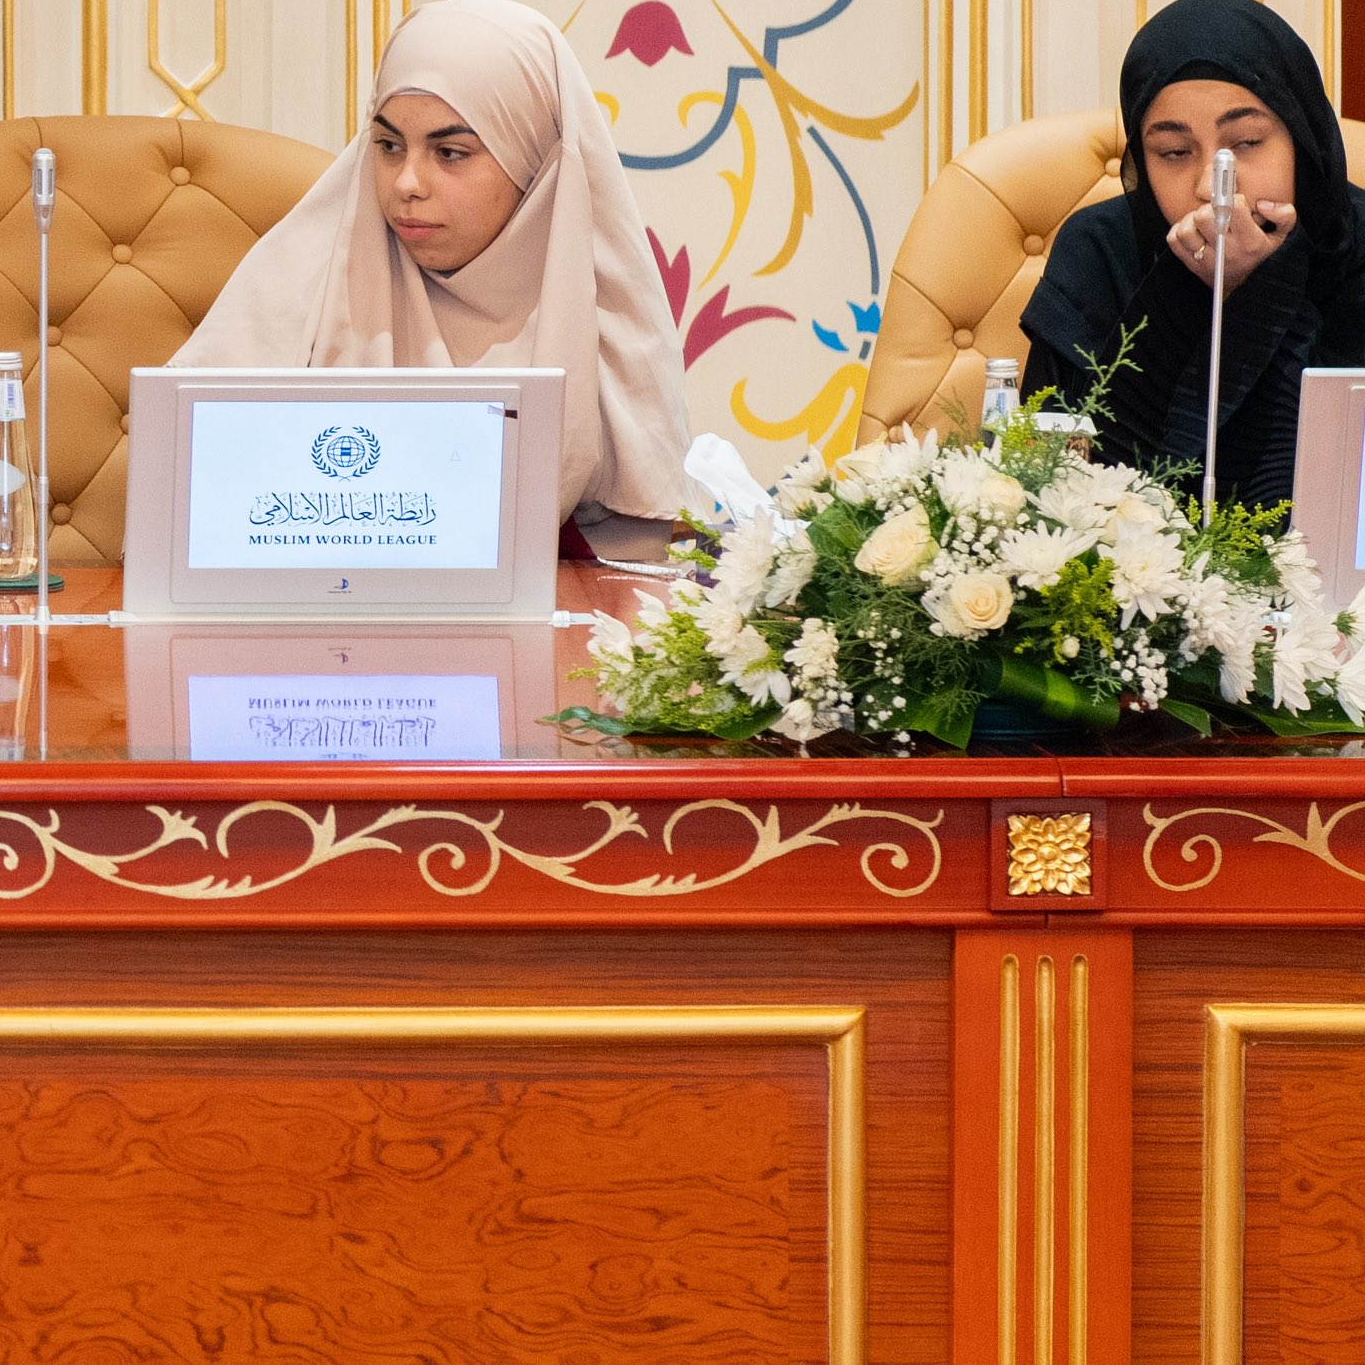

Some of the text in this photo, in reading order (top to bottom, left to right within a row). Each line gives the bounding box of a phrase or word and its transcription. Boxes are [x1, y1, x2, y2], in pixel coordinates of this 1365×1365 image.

[248, 534, 437, 545] MUSLIM WORLD LEAGUE
